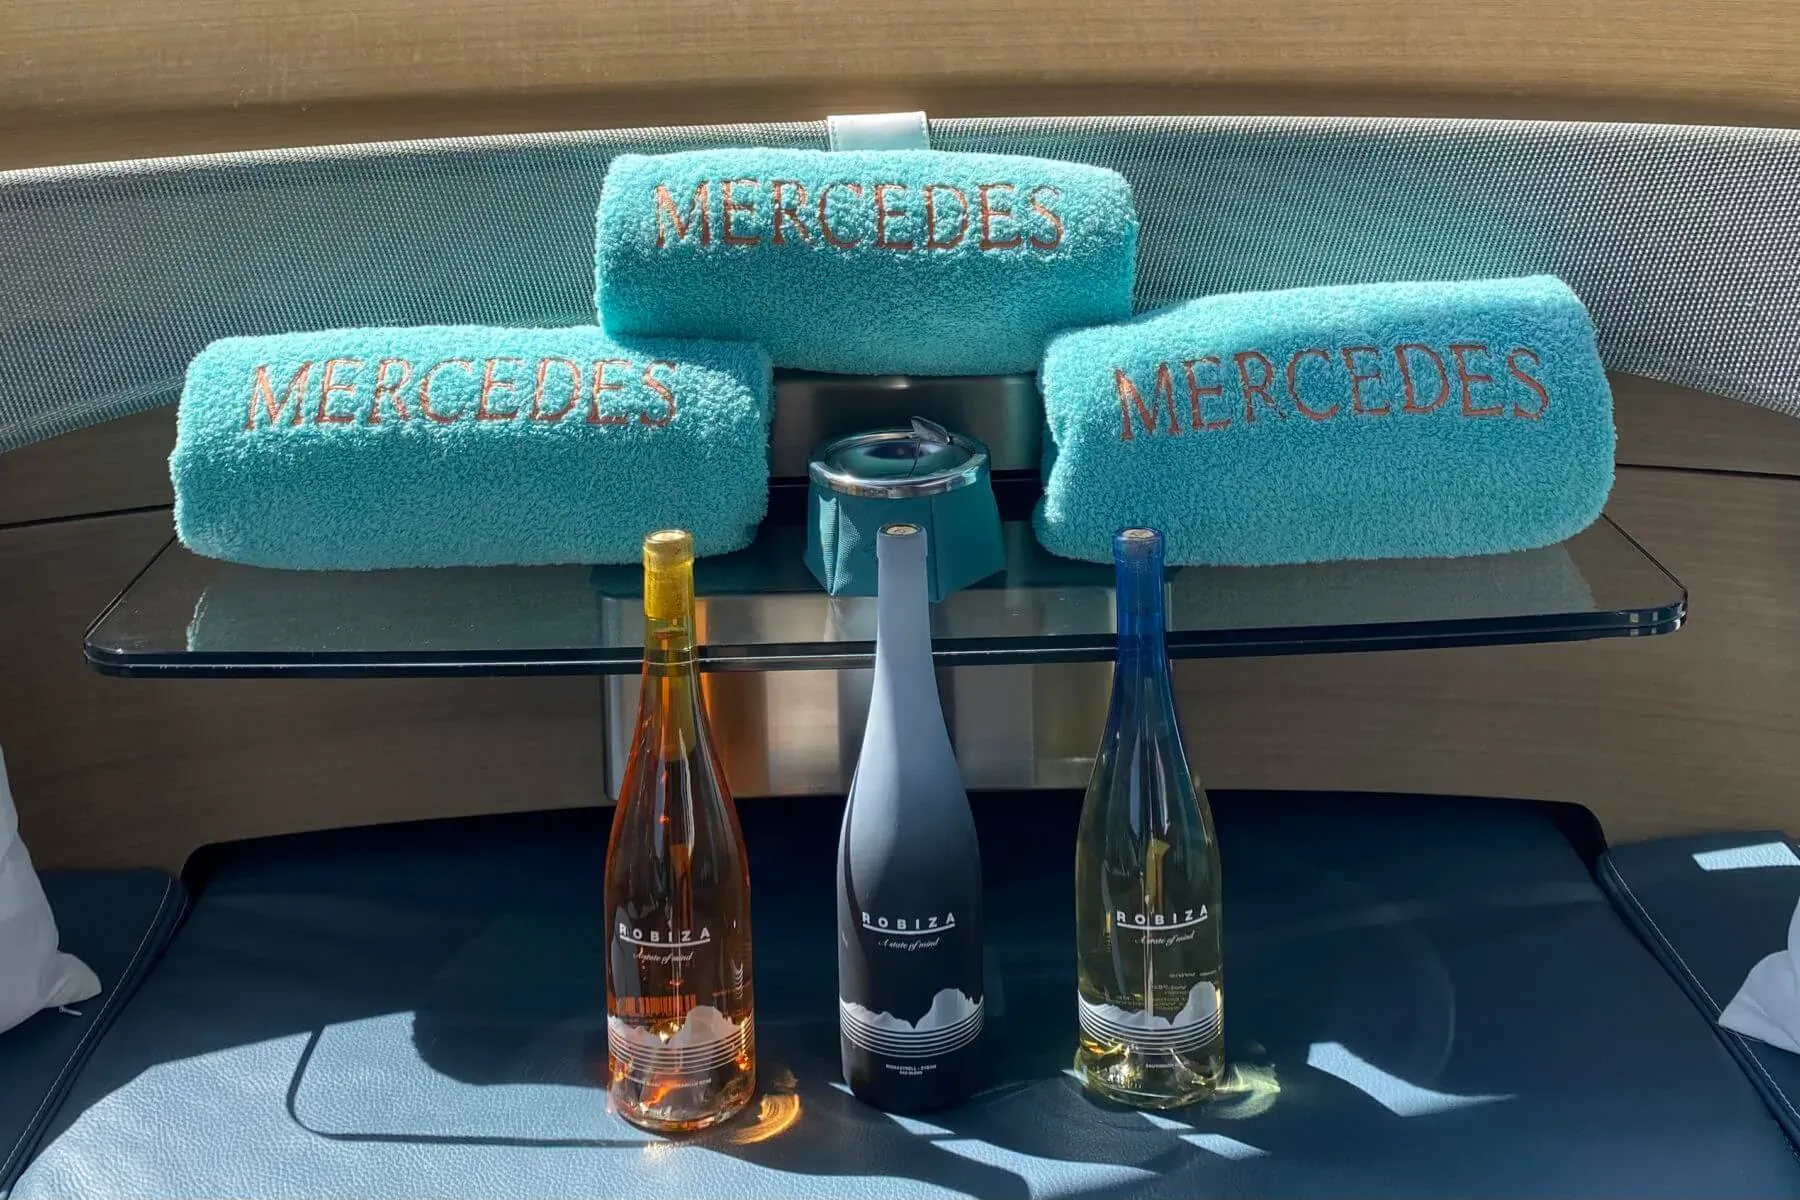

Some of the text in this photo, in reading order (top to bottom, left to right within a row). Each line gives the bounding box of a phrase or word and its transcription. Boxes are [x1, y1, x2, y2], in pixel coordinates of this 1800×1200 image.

[654, 178, 1065, 251] MERCEDES
[245, 356, 679, 432] MERCEDES
[1111, 343, 1550, 441] MERCEDES
[862, 911, 956, 930] ROBIZA
[1116, 904, 1209, 926] ROBIZA
[619, 922, 711, 943] ROBIZA
[1166, 935, 1178, 947] of
[1177, 928, 1196, 943] mind
[888, 940, 908, 950] state
[907, 940, 920, 952] of
[919, 936, 941, 948] mind
